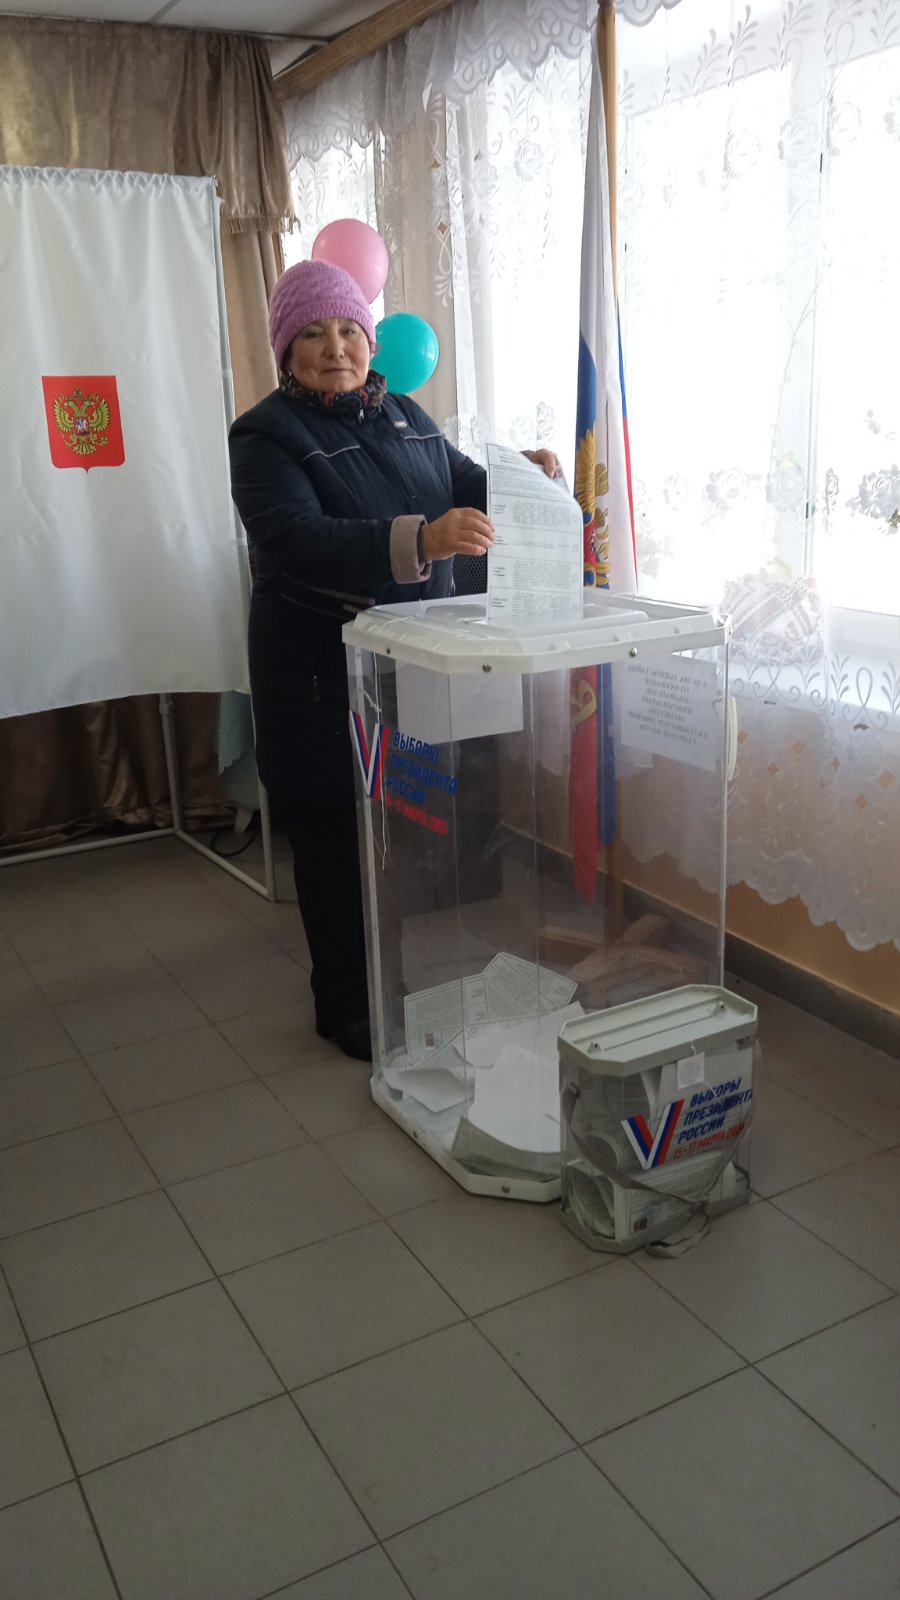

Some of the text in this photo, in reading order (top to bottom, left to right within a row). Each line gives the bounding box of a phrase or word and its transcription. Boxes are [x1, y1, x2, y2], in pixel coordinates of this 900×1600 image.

[394, 731, 440, 762] ВЫБОРЫ
[689, 1077, 742, 1108] ВЫБОРЫ
[677, 1115, 726, 1145] РОССИИ
